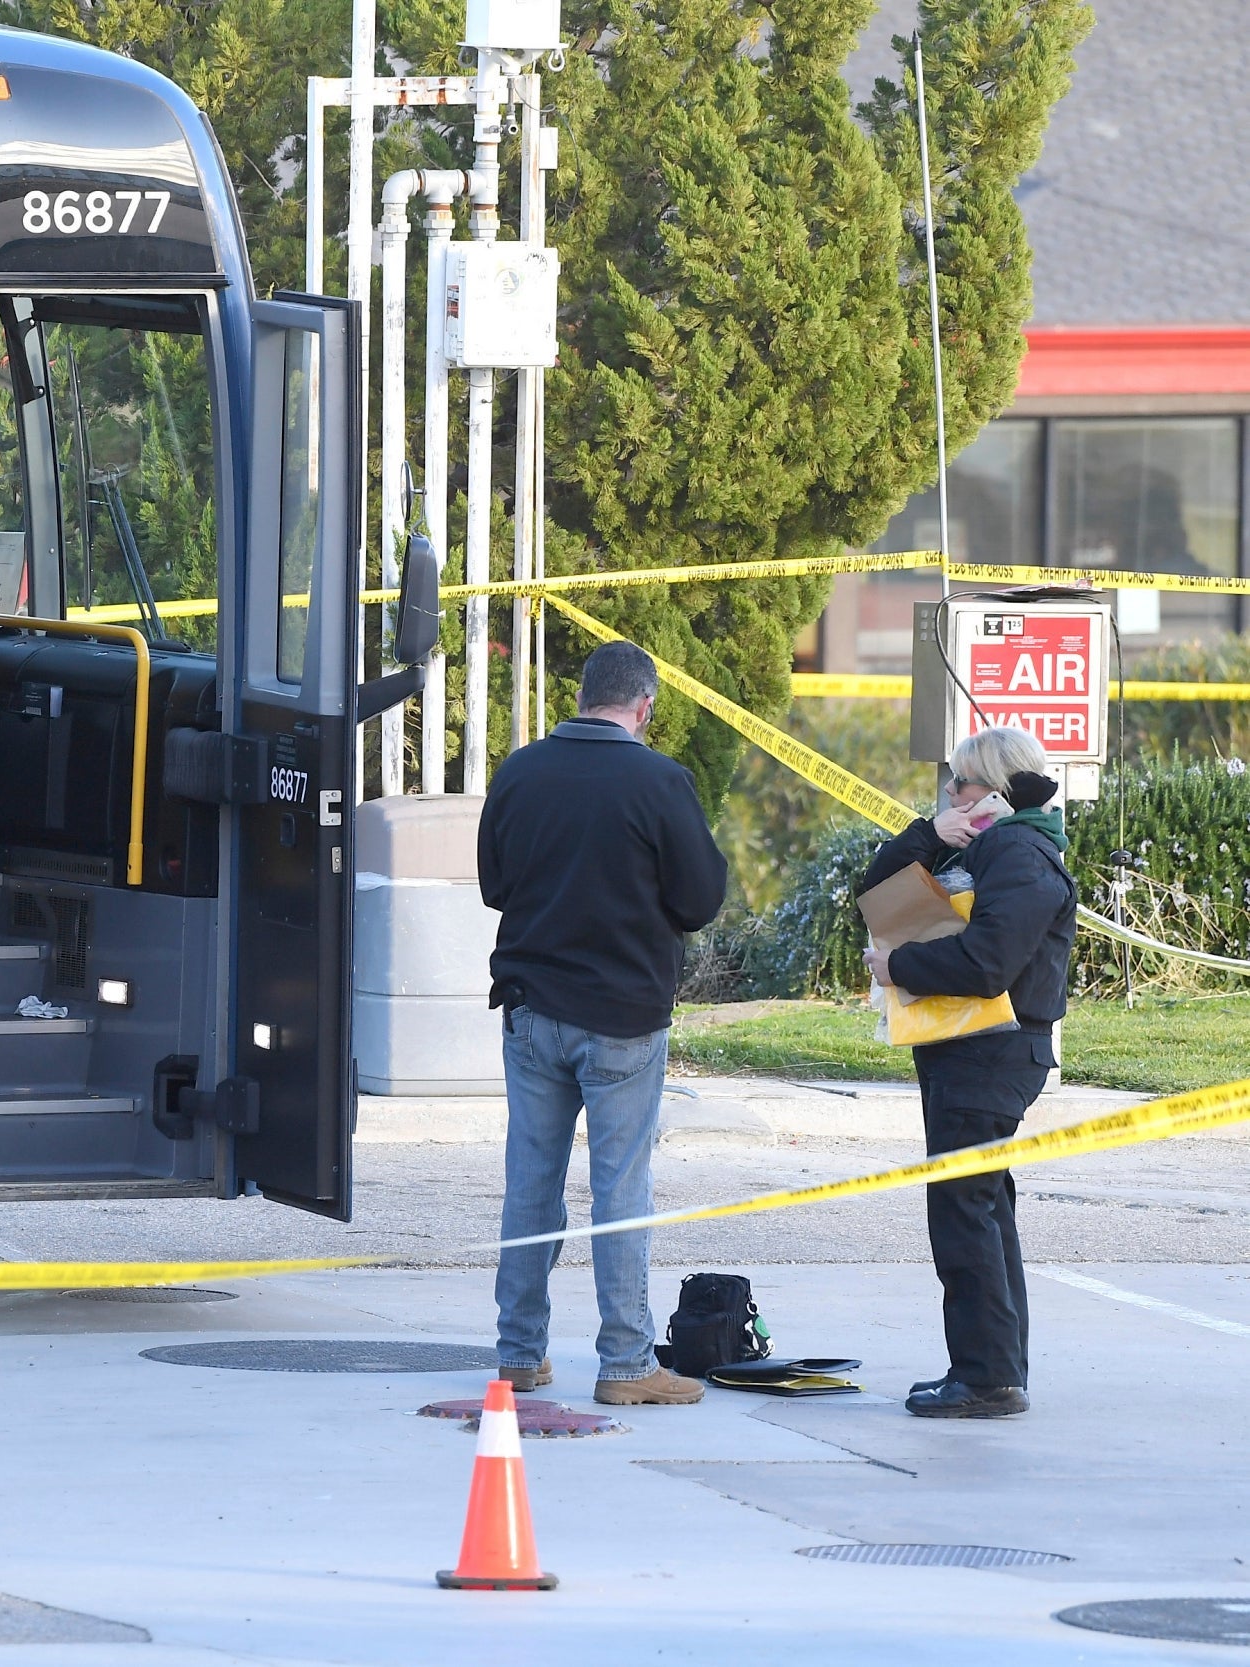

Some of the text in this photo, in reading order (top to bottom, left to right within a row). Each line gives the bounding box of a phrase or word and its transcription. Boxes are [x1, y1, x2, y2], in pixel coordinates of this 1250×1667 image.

[23, 190, 171, 234] 86877
[836, 558, 852, 573] LINE
[854, 557, 863, 572] DO
[865, 555, 880, 571] NOT
[882, 554, 905, 570] CROSS
[954, 564, 1014, 578] DO NOT CROSS
[1038, 567, 1071, 580] SHERIFF
[1094, 570, 1106, 581] DO
[1109, 571, 1124, 582] NOT
[1007, 653, 1086, 692] AIR
[271, 766, 308, 804] 86877
